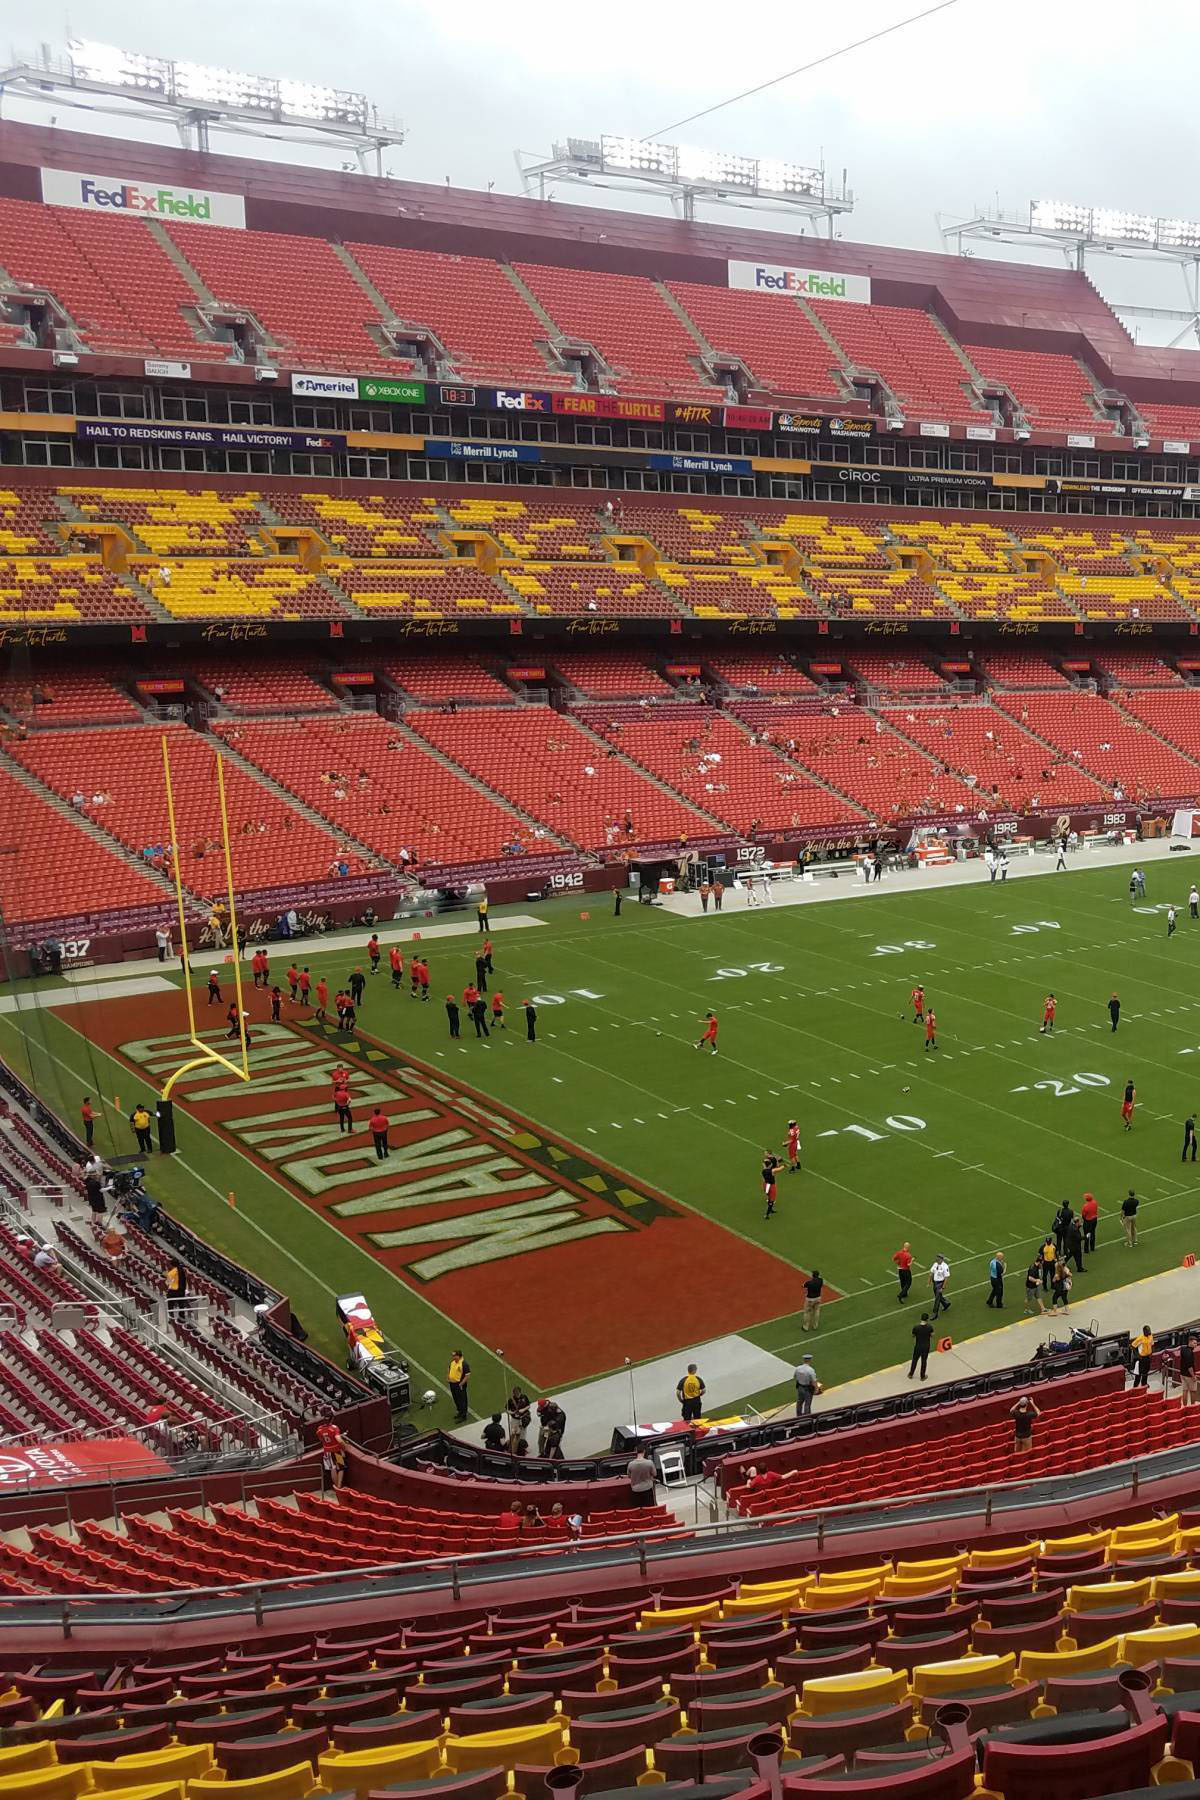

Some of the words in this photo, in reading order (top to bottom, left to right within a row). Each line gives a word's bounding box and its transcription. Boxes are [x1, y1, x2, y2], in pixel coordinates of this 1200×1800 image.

[305, 379, 355, 393] Ameritel
[378, 386, 399, 397] XBOX
[400, 387, 420, 397] ONE
[496, 391, 545, 410] FedEx
[86, 426, 111, 437] HAIL
[112, 427, 127, 437] TO
[130, 428, 183, 440] REDSKINS
[185, 431, 215, 442] FANS.
[222, 434, 246, 444] HAIL
[247, 435, 292, 446] VICTORY!
[463, 446, 492, 457] Merrill
[494, 447, 518, 459] Lynch
[684, 458, 710, 469] Merrill
[711, 460, 733, 471] Lynch
[908, 475, 930, 483] ULTRA
[931, 476, 962, 485] PREMIUM
[964, 478, 986, 486] VODKA
[1104, 814, 1126, 826] 1983
[836, 836, 851, 850] the
[736, 847, 765, 861] 1972
[550, 873, 584, 888] 1942
[716, 962, 785, 978] 20
[532, 988, 607, 1005] 10
[1034, 1072, 1111, 1096] 20
[842, 1114, 927, 1142] 10
[117, 1022, 638, 1284] MARYLAND
[1186, 1255, 1195, 1267] 10
[942, 1339, 952, 1351] G
